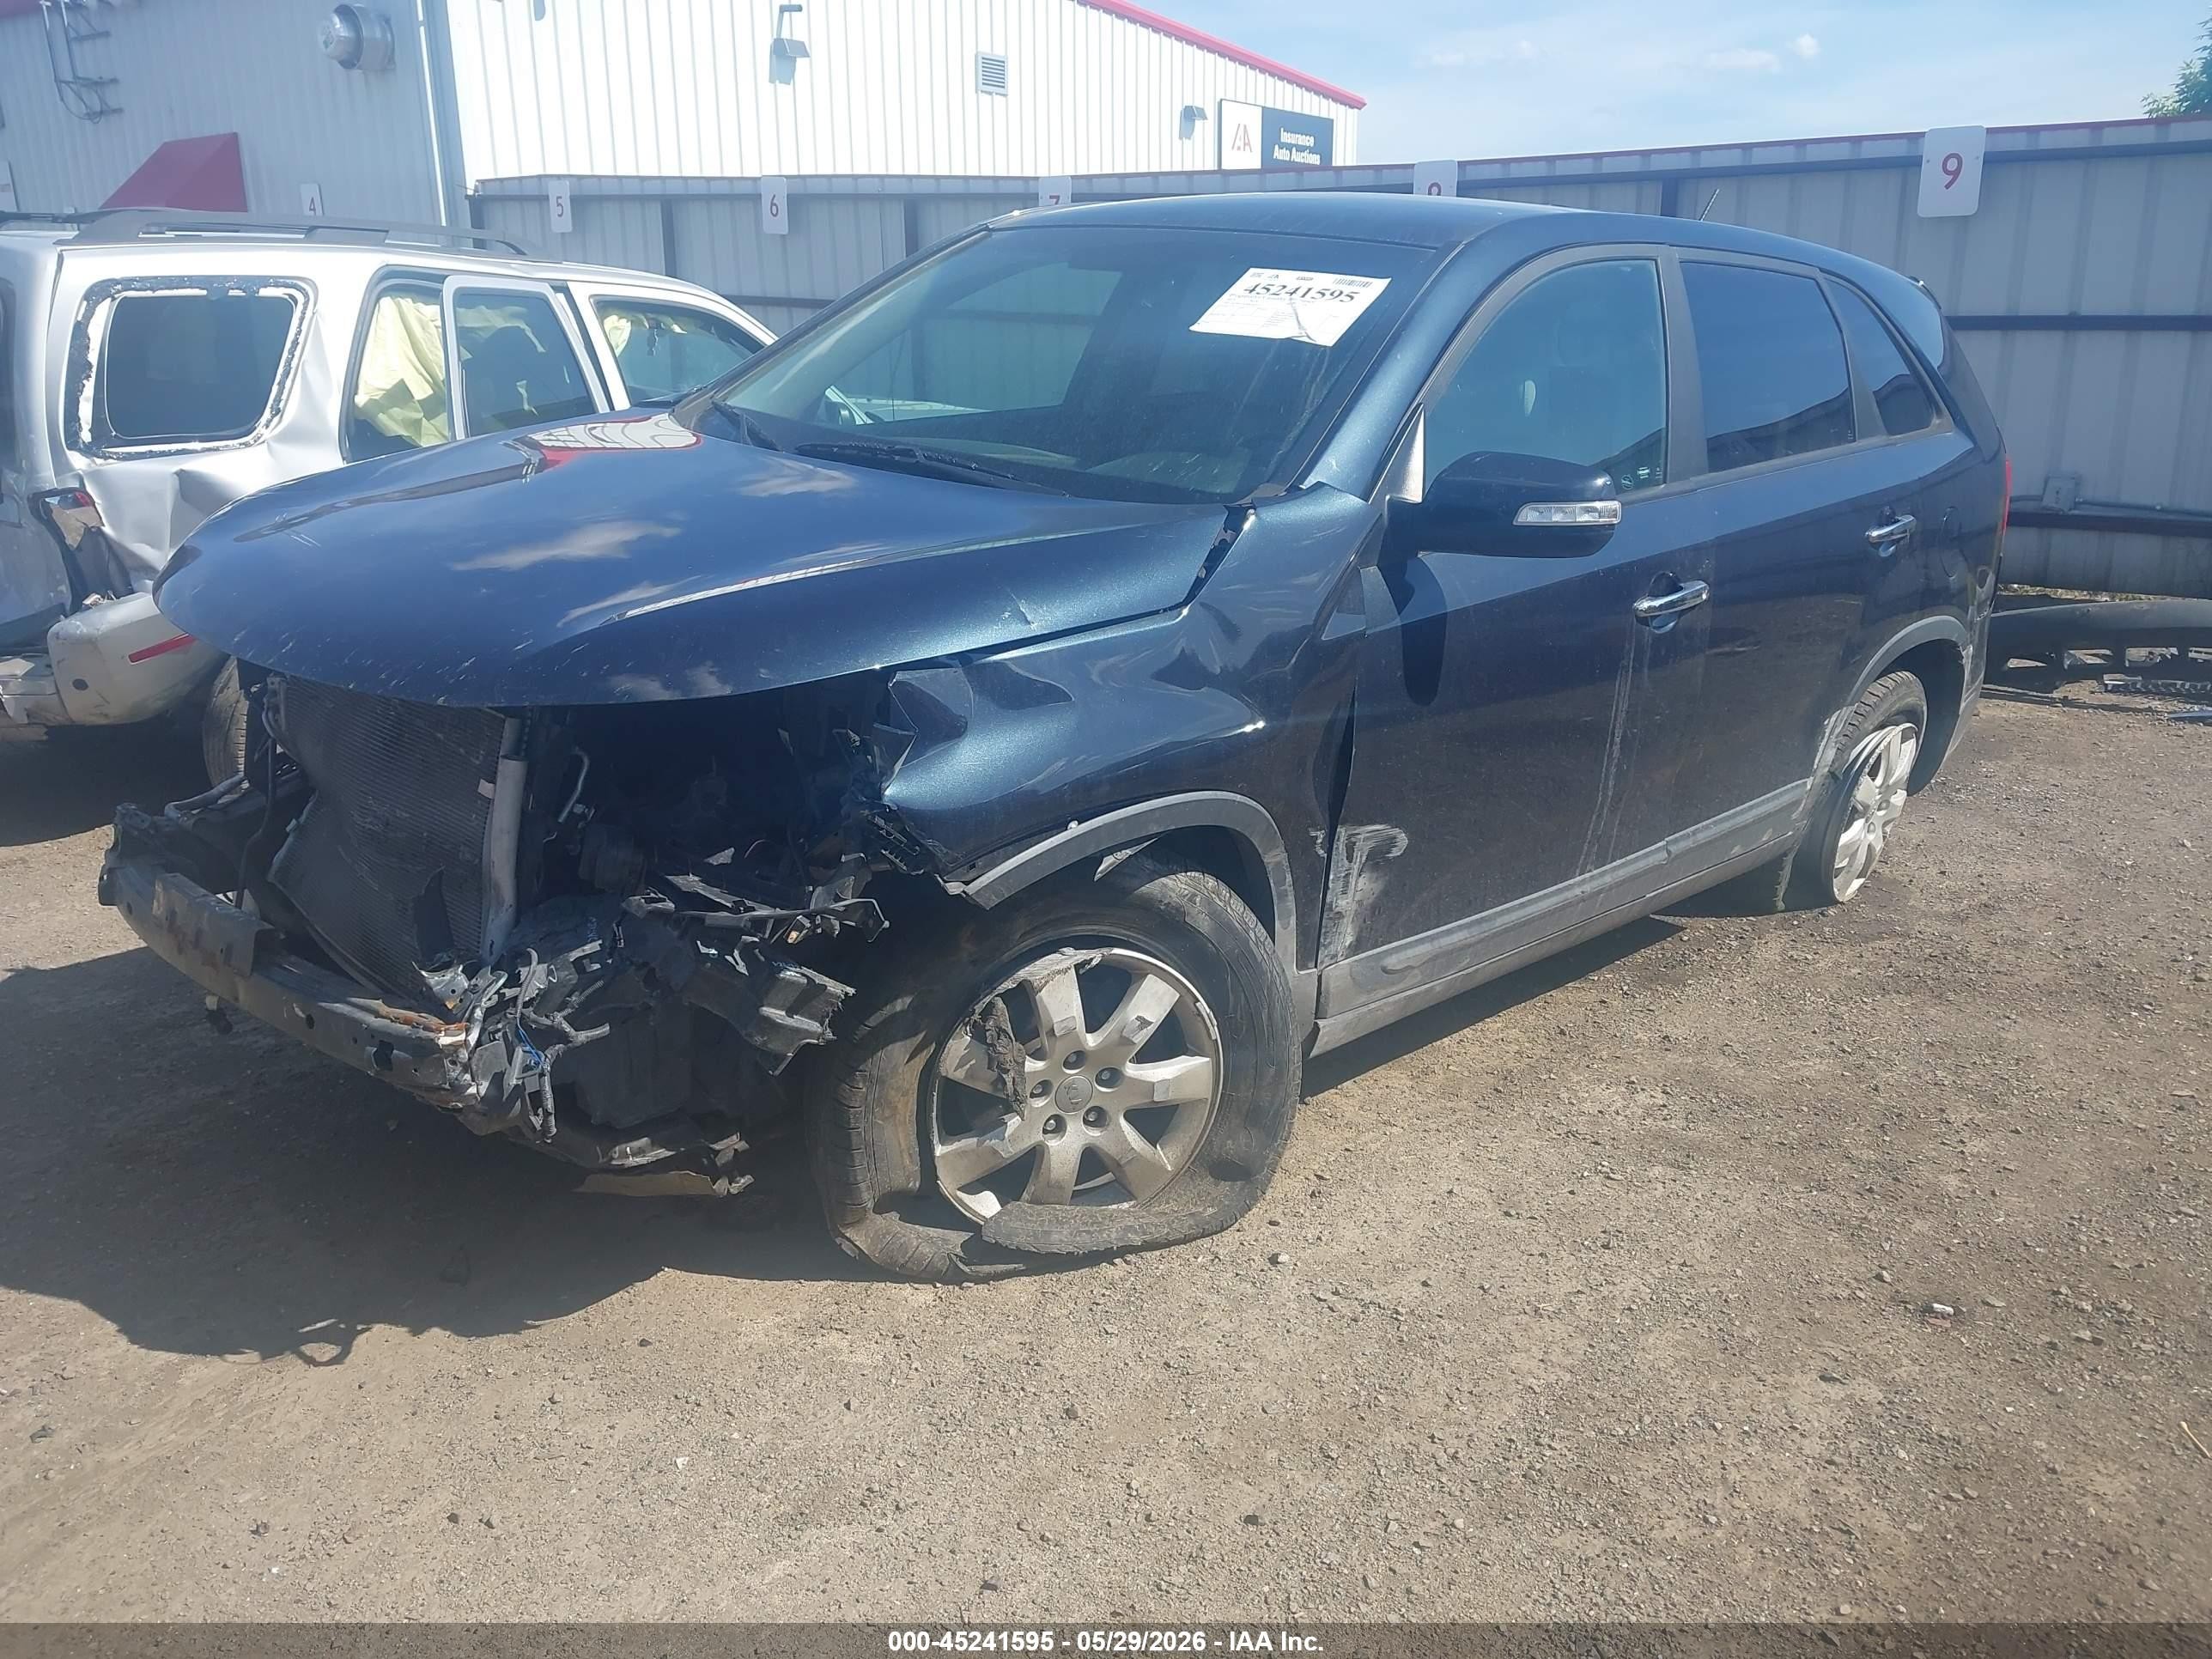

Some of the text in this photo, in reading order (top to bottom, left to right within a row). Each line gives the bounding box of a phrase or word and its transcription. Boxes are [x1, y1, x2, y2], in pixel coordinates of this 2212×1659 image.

[1280, 127, 1315, 147] Insurance
[1273, 143, 1321, 166] Auto Auctions
[1942, 153, 1963, 190] 9
[308, 197, 317, 216] 4
[556, 196, 564, 217] 5
[769, 194, 779, 217] 6
[1243, 283, 1360, 302] 45241595
